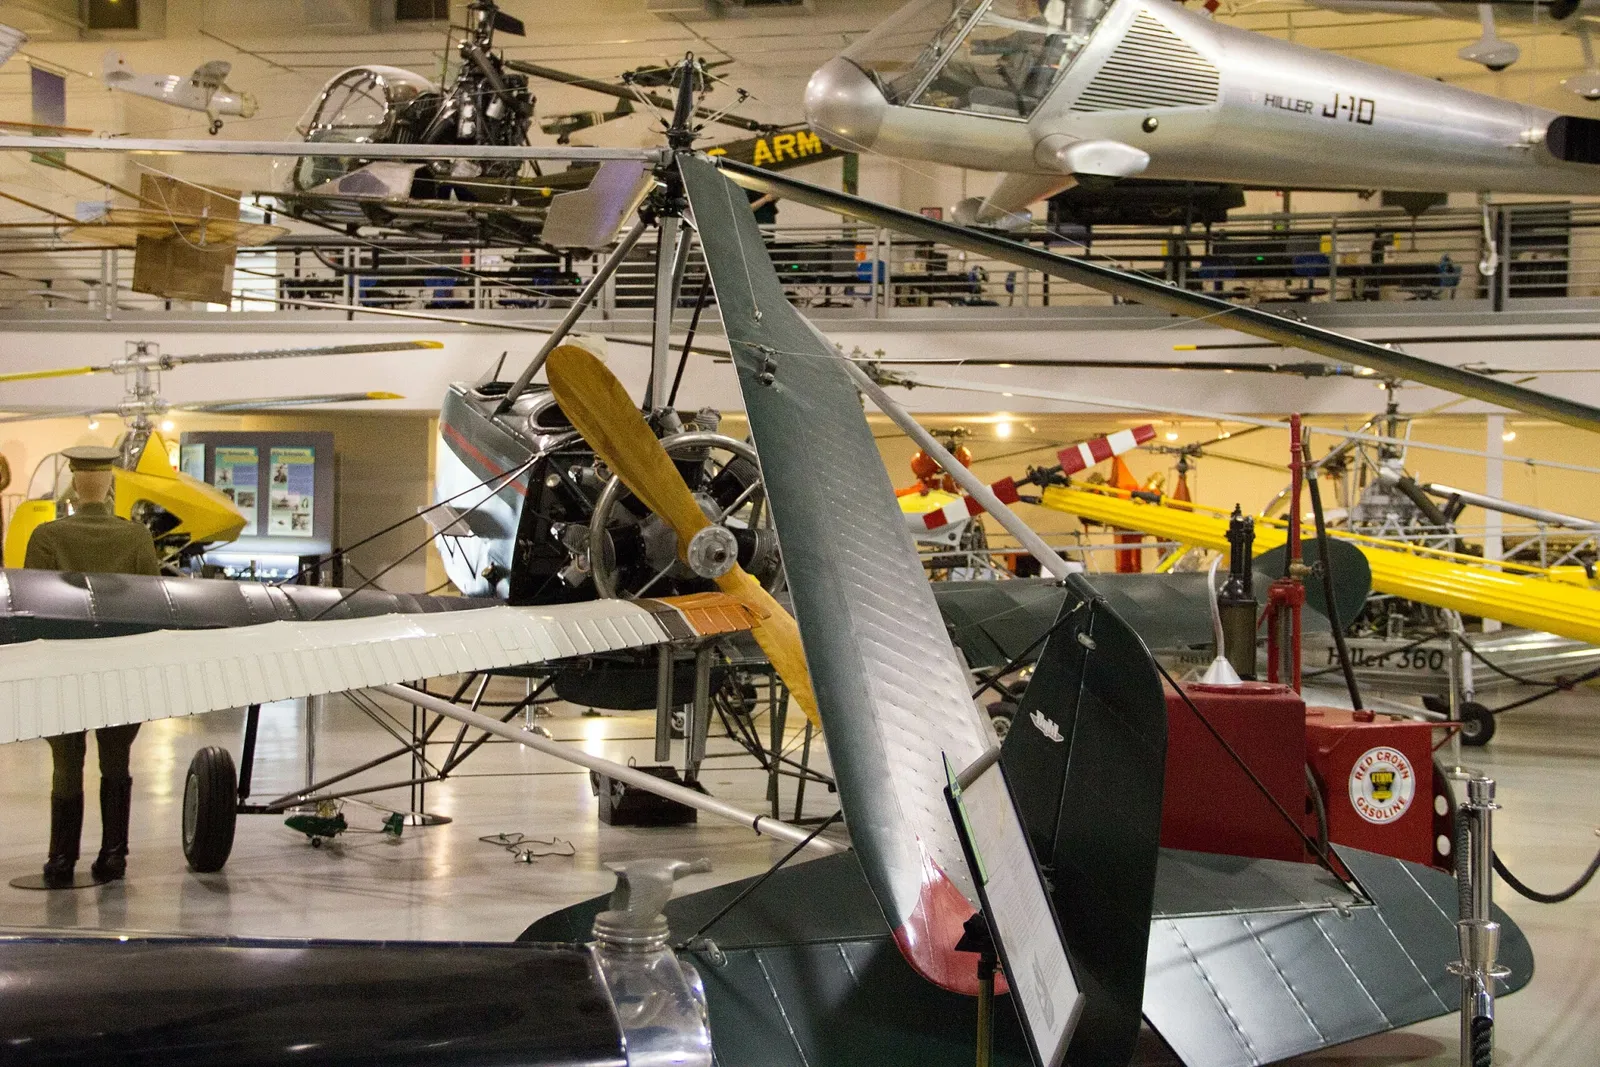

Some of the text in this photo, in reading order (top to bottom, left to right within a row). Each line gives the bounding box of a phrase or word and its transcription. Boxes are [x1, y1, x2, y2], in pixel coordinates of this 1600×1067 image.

[1264, 93, 1375, 125] HILLER J-10
[752, 131, 826, 167] ARM
[1327, 646, 1444, 670] Hller 360
[1355, 751, 1409, 780] RED CROWN
[1357, 796, 1406, 819] GASOLINE
